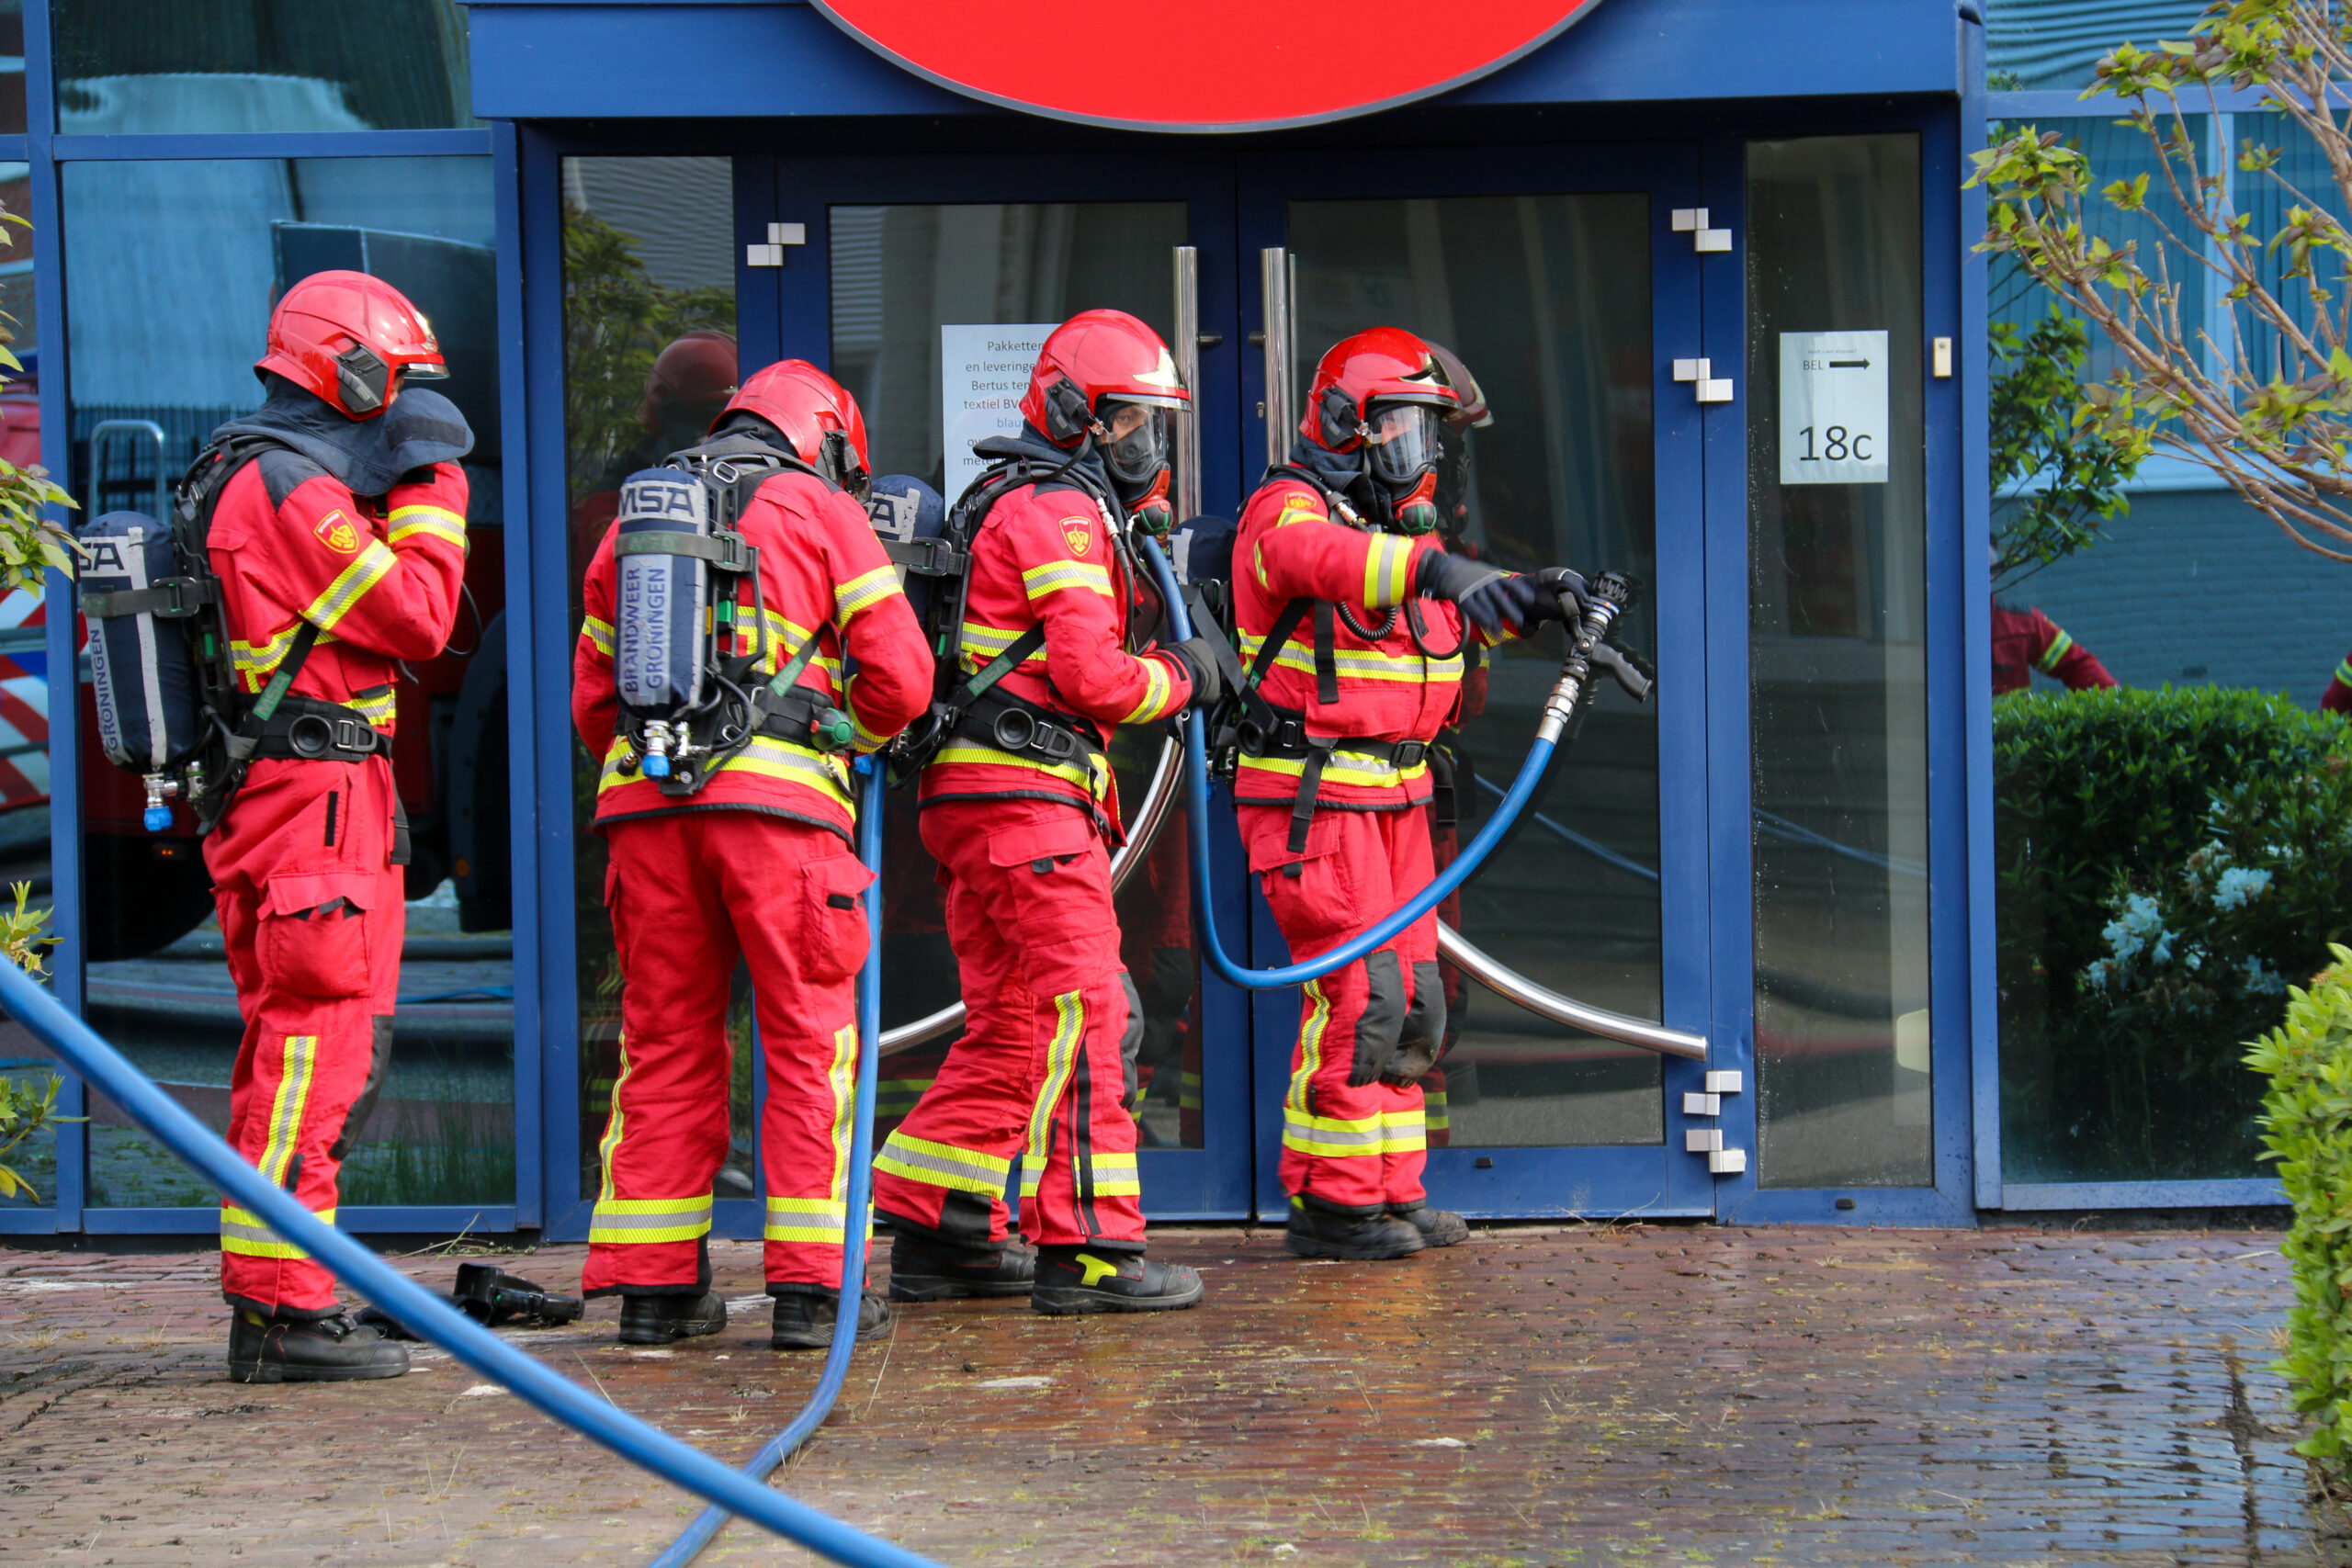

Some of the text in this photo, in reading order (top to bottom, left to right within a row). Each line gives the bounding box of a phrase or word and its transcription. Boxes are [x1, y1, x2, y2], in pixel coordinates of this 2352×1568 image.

[988, 341, 1044, 352] Pakketten
[966, 361, 1035, 373] en leveringe
[1803, 359, 1824, 370] BEL
[971, 380, 1009, 390] Bertus
[964, 399, 1019, 410] textiel BV
[997, 417, 1023, 428] blau
[1799, 425, 1872, 461] 18c
[618, 486, 695, 517] MSA
[79, 542, 125, 570] SA
[624, 567, 640, 694] BRANDWEER
[646, 569, 665, 689] GRONINGEN
[89, 629, 119, 751] GRONINGEN
[257, 675, 289, 716] MSA
